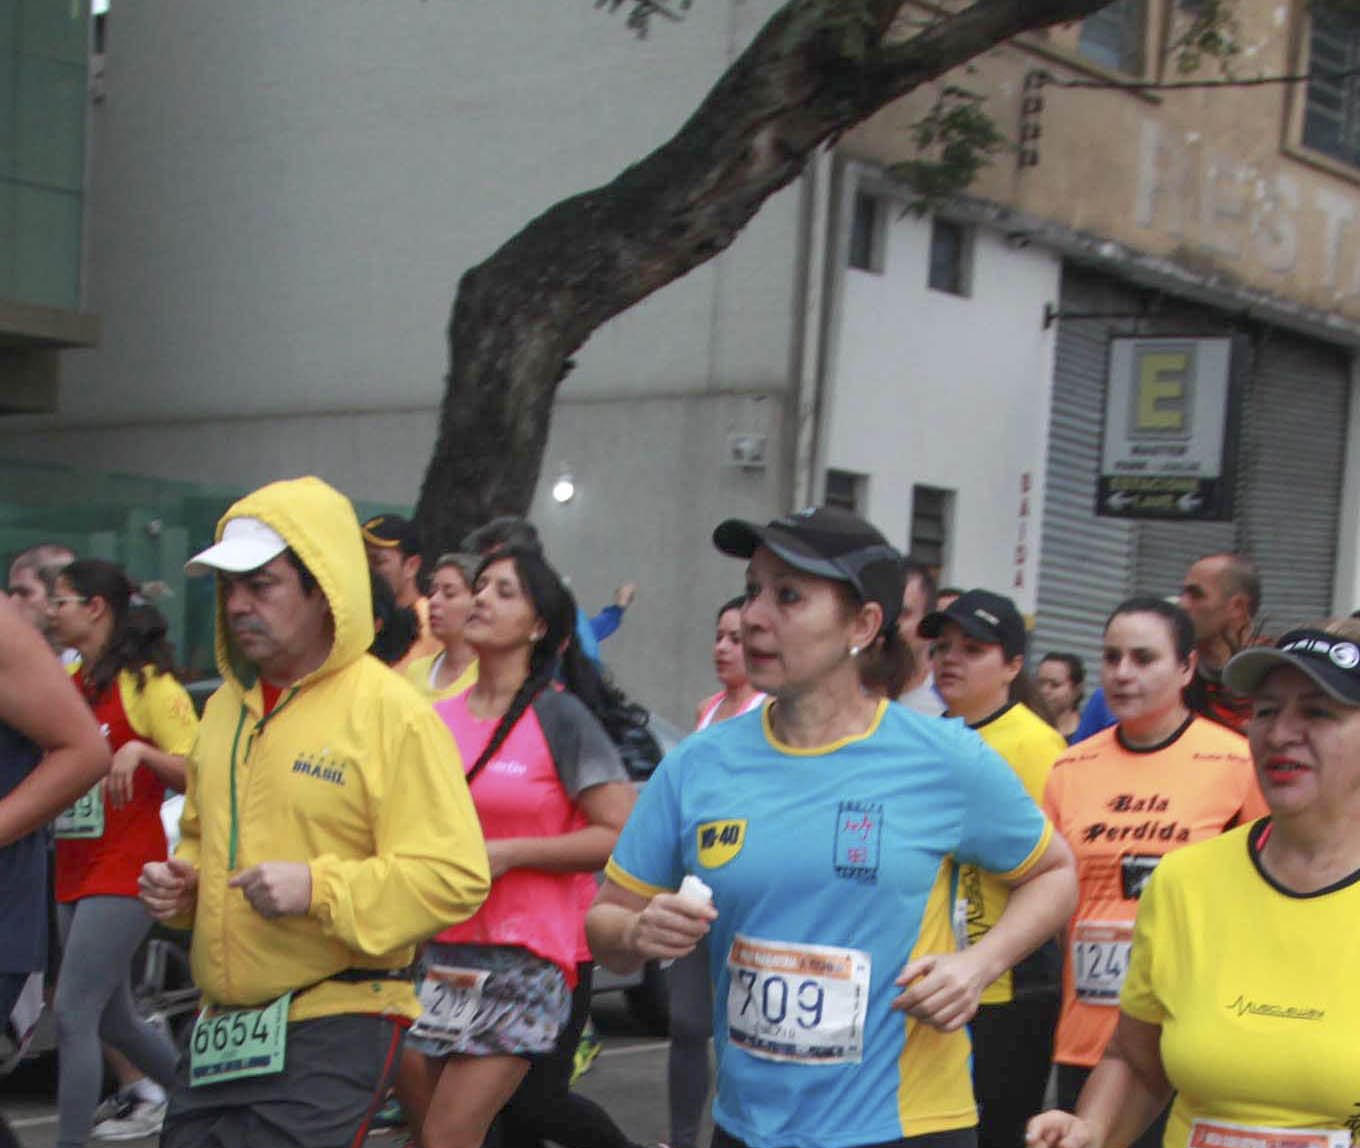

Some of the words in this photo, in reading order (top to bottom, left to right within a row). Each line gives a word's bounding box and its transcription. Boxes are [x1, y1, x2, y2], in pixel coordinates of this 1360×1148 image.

[1137, 352, 1187, 430] E
[292, 760, 344, 786] BRASIL
[1107, 794, 1170, 813] Bala
[1082, 821, 1190, 843] Perdida
[1077, 942, 1133, 980] 124
[739, 969, 824, 1029] 709
[194, 1010, 268, 1055] 6654
